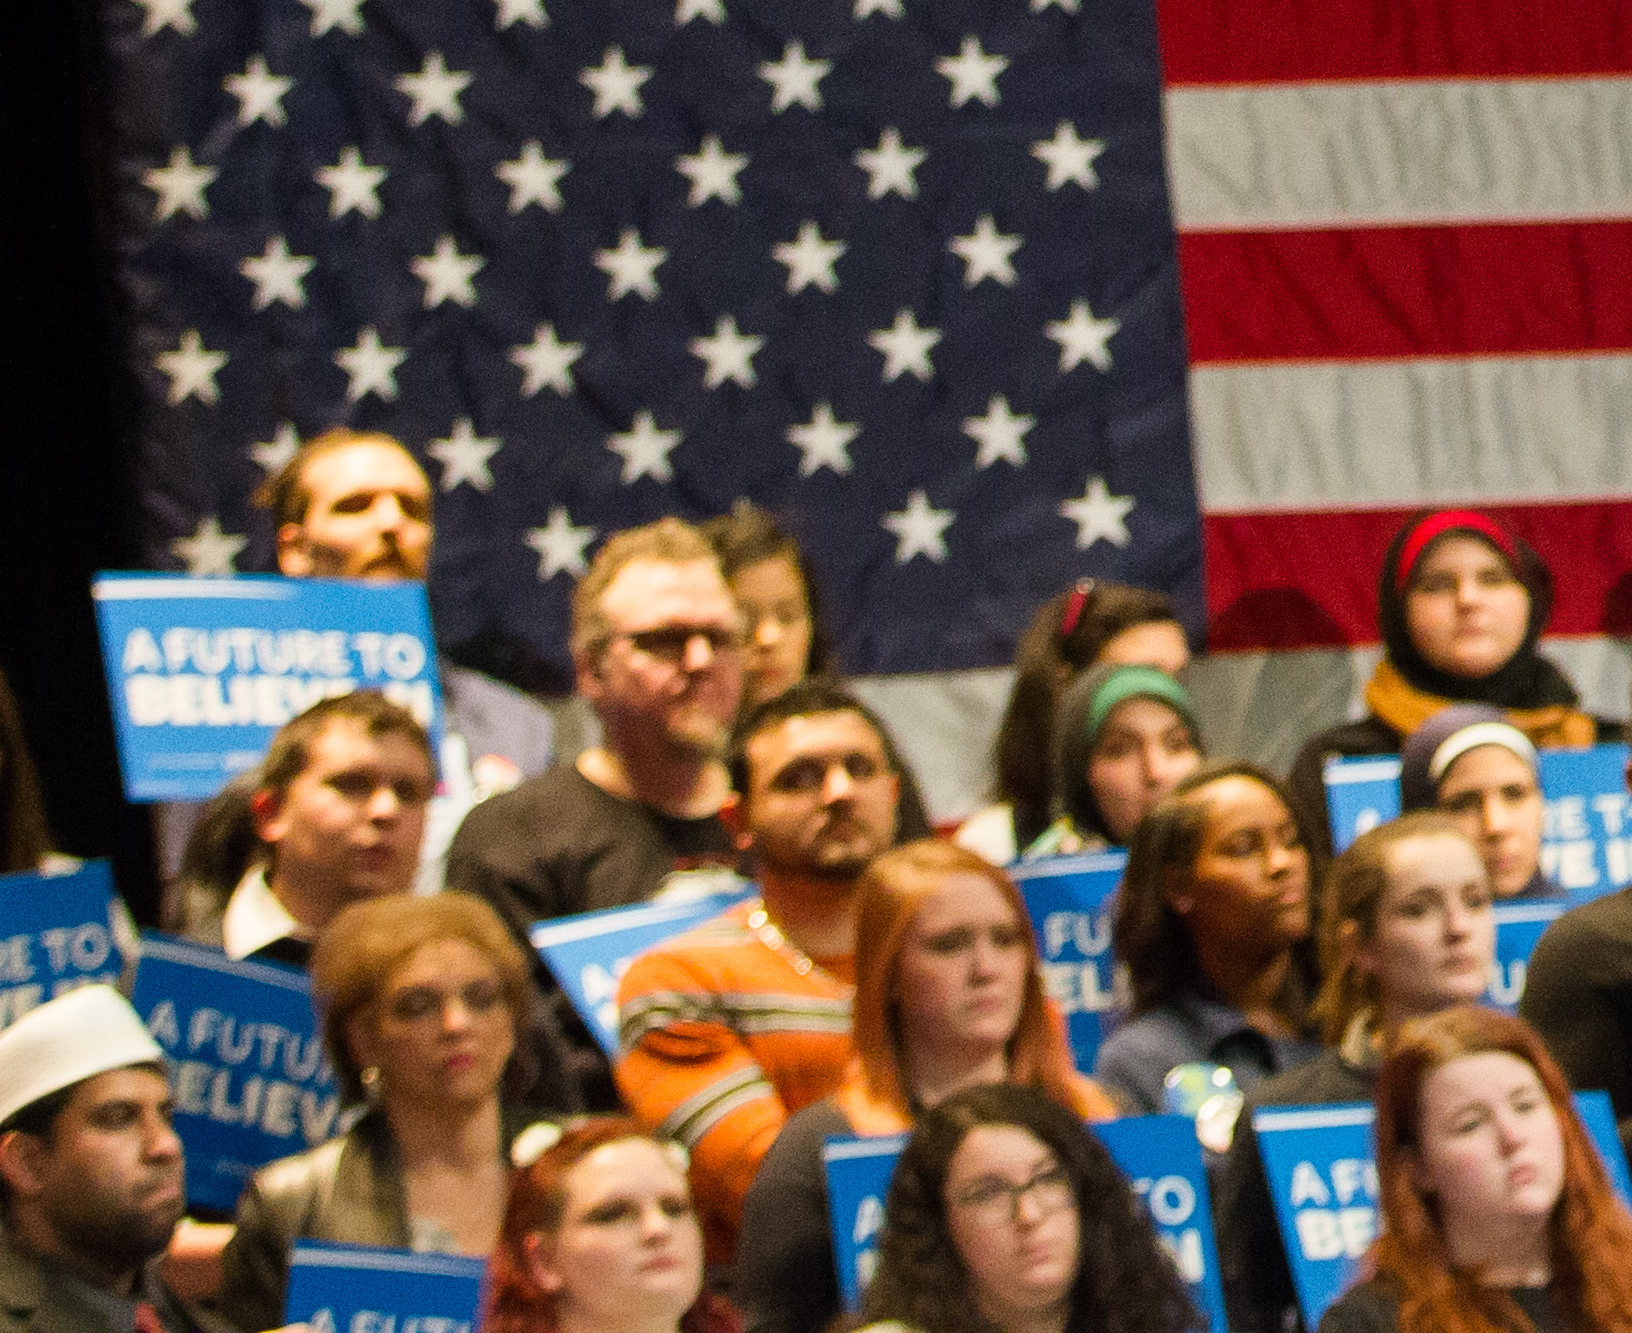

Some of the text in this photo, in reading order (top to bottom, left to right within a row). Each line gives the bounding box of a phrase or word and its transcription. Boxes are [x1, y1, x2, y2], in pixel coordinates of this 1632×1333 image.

[121, 626, 427, 682] A FUTURE TO
[41, 921, 112, 975] TO
[149, 999, 181, 1050] A
[172, 1060, 352, 1148] ELIEV
[1290, 1160, 1332, 1208] A
